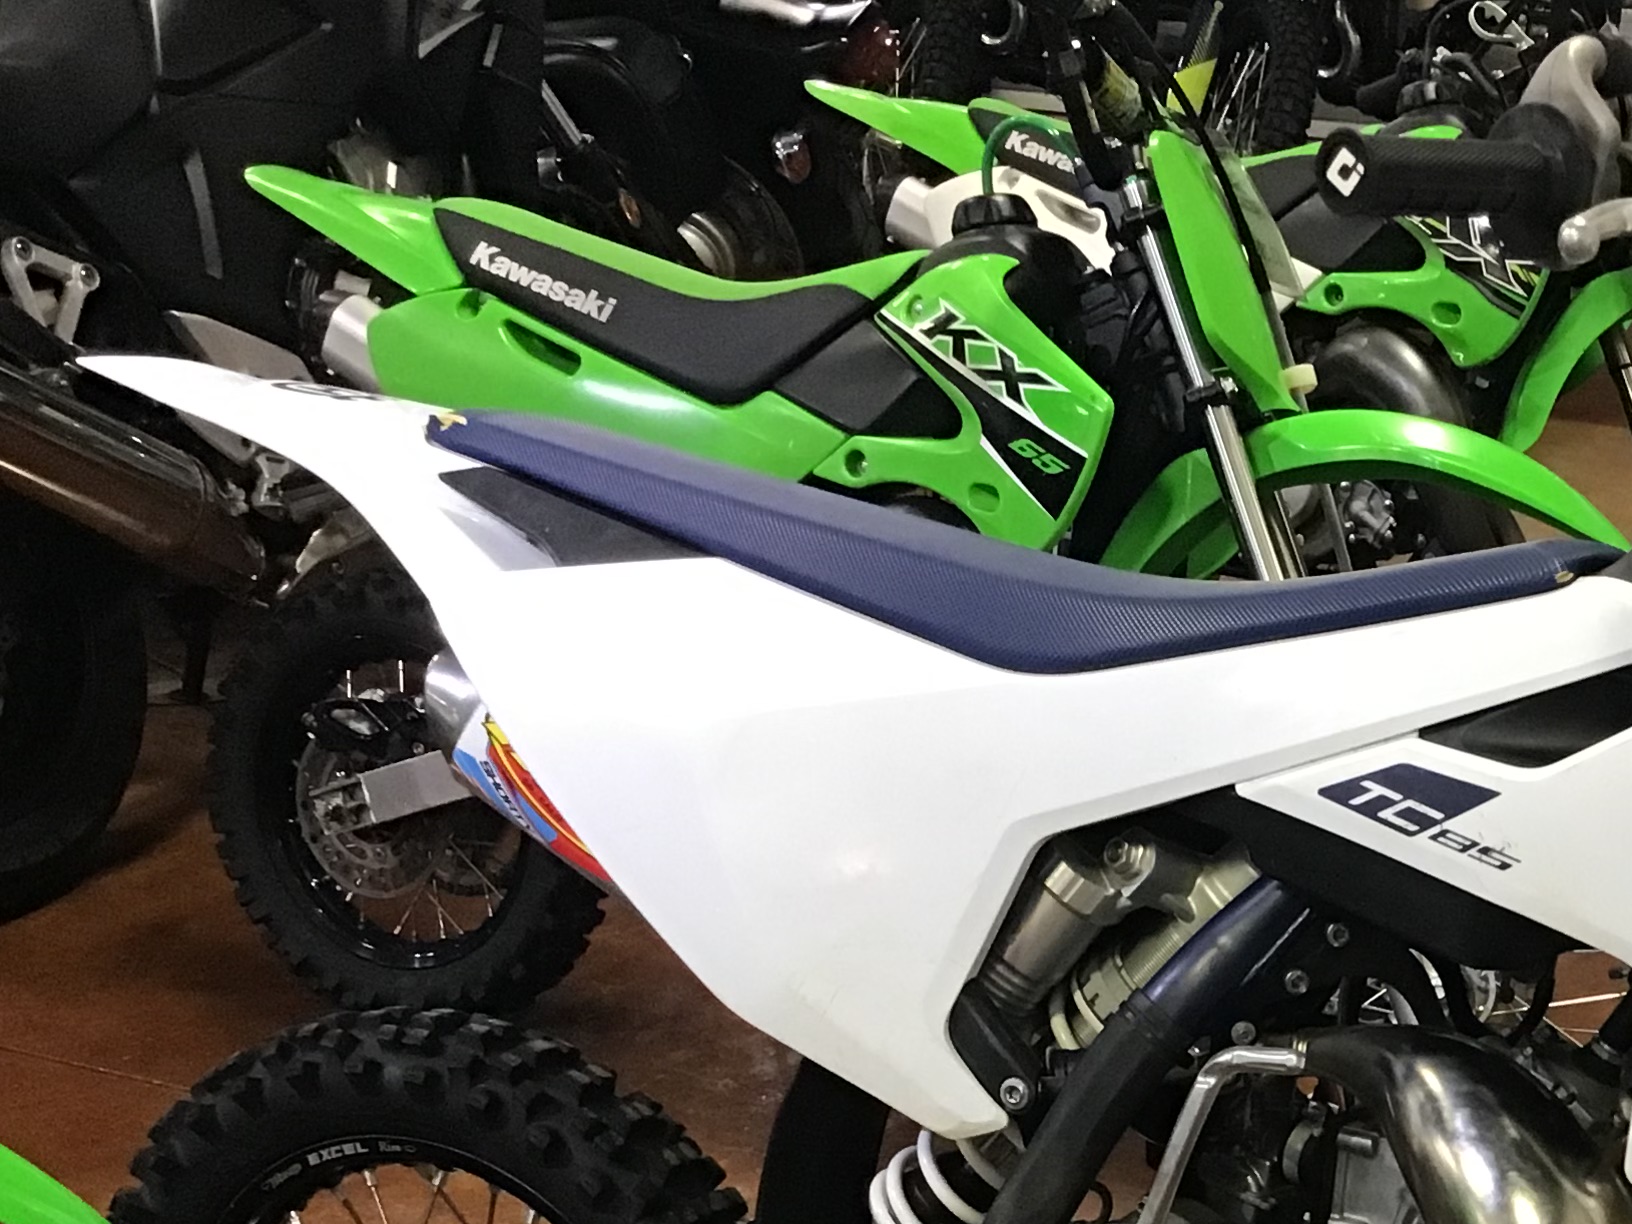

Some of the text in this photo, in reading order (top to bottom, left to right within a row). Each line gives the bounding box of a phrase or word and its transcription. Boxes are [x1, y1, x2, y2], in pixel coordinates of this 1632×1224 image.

[1004, 129, 1075, 175] Kawa
[469, 240, 617, 323] Kawasaki
[912, 298, 1070, 416] KX
[1007, 437, 1070, 475] 65
[1347, 780, 1522, 871] TC 85
[306, 1141, 369, 1166] EXCEL
